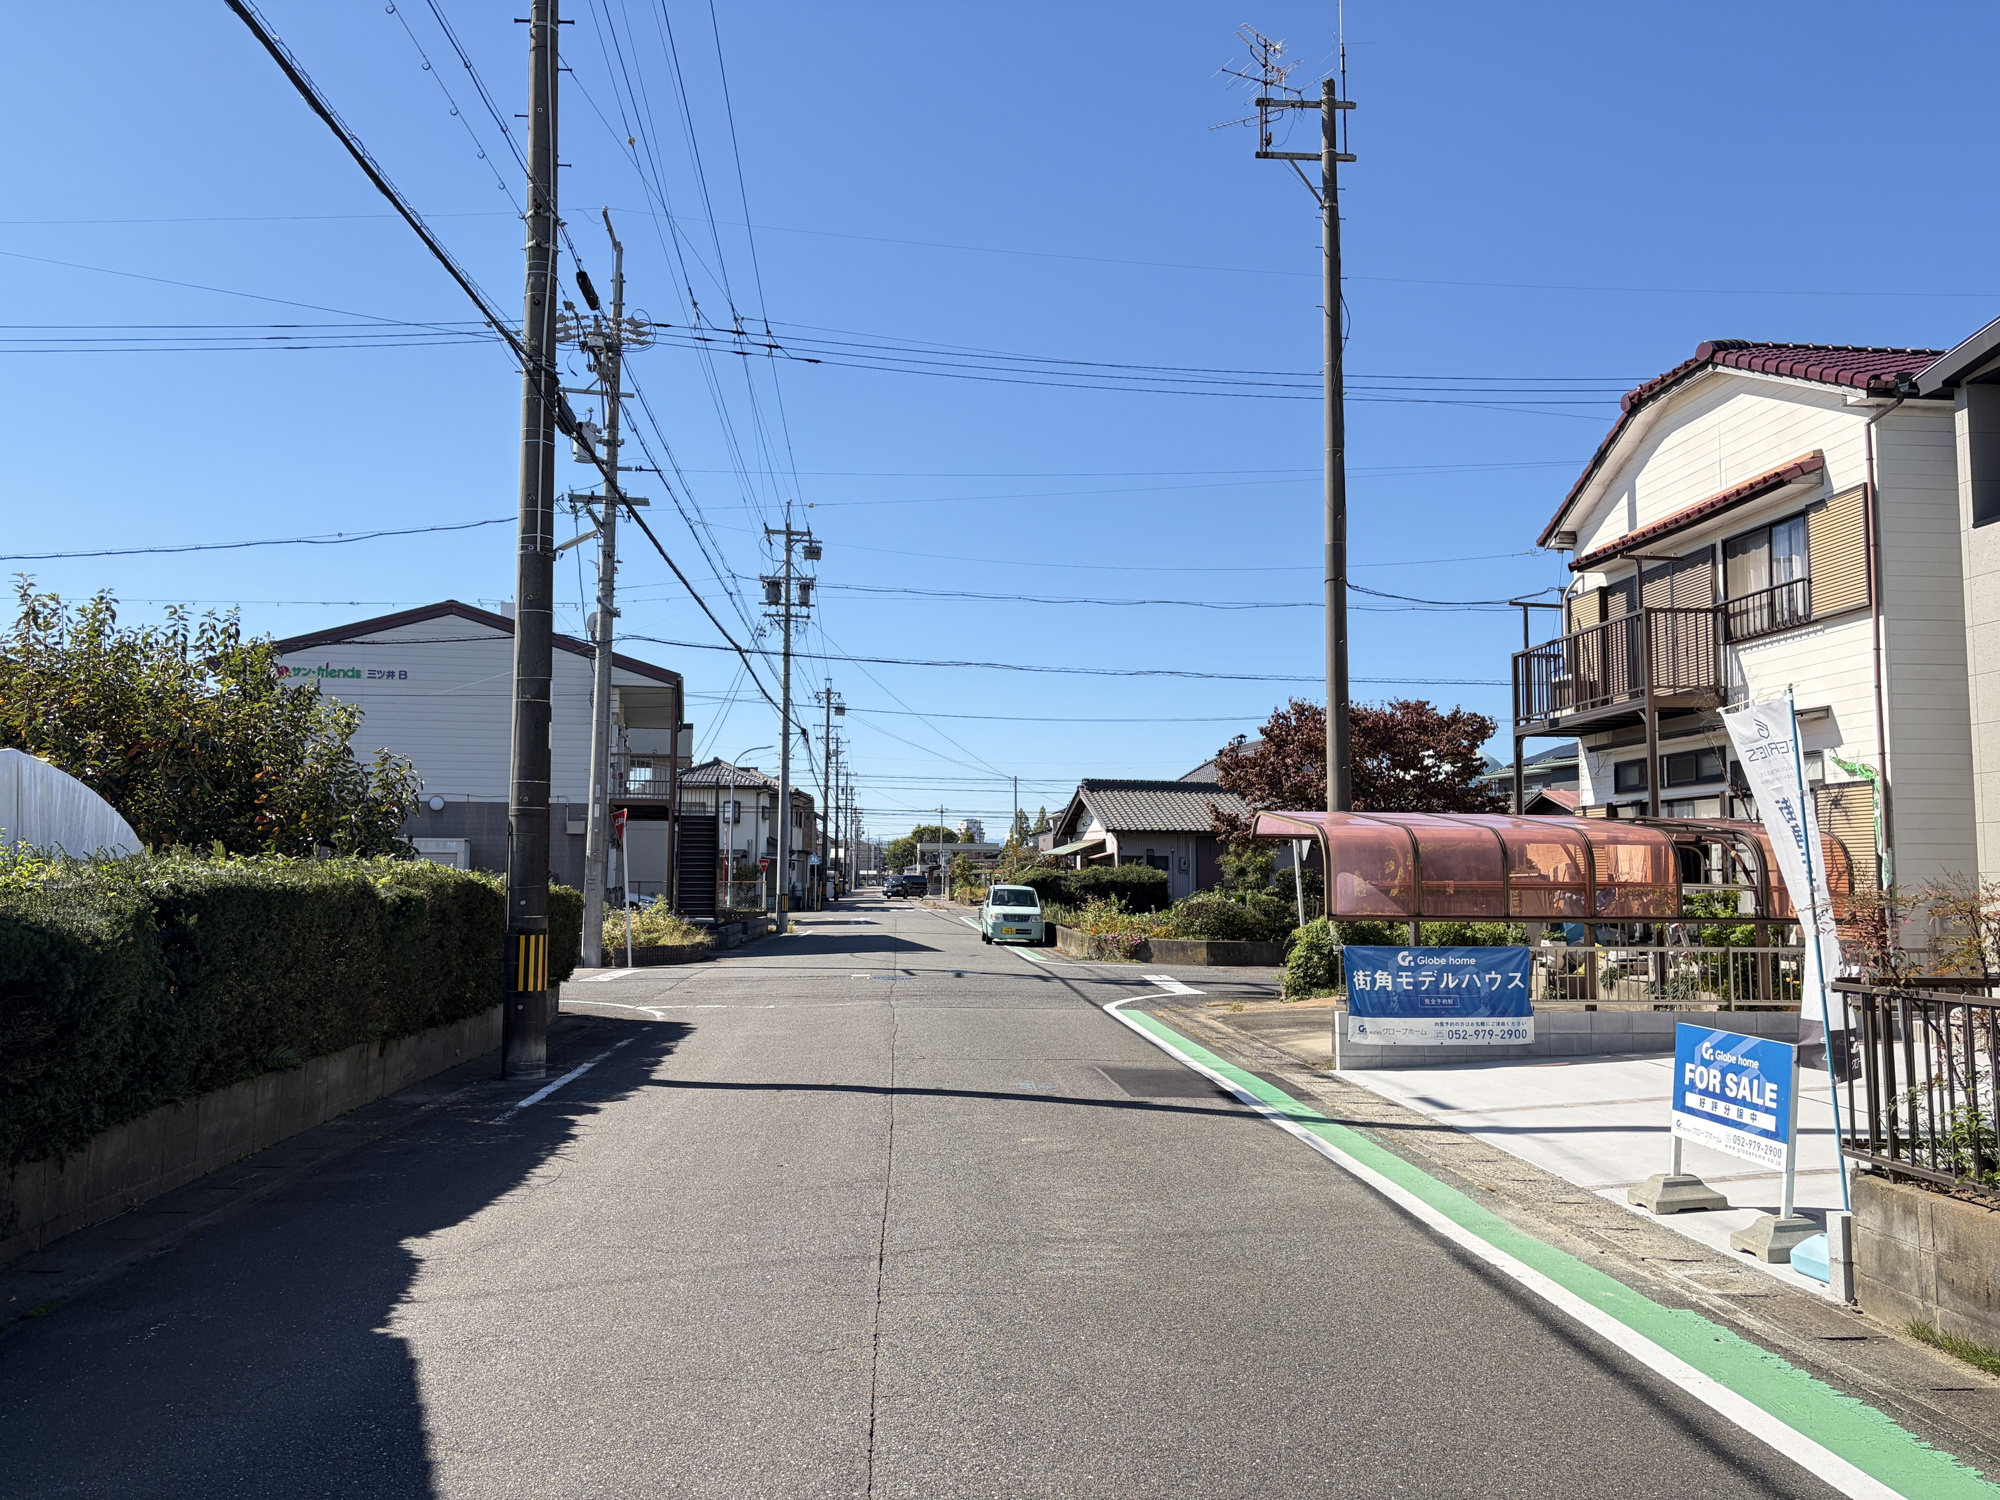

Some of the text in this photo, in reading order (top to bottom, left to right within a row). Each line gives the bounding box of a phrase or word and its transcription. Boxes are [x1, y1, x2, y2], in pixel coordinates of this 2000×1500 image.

[367, 669, 396, 680] 三ツ井
[398, 670, 408, 680] B
[1417, 956, 1476, 965] Globe home
[1353, 970, 1525, 991] 街角モデルハウス
[1447, 1029, 1528, 1040] 052-979-2900
[1715, 1050, 1759, 1070] Globe home
[1684, 1062, 1778, 1110] FOR SALE
[1732, 1134, 1782, 1158] 052-979-2900
